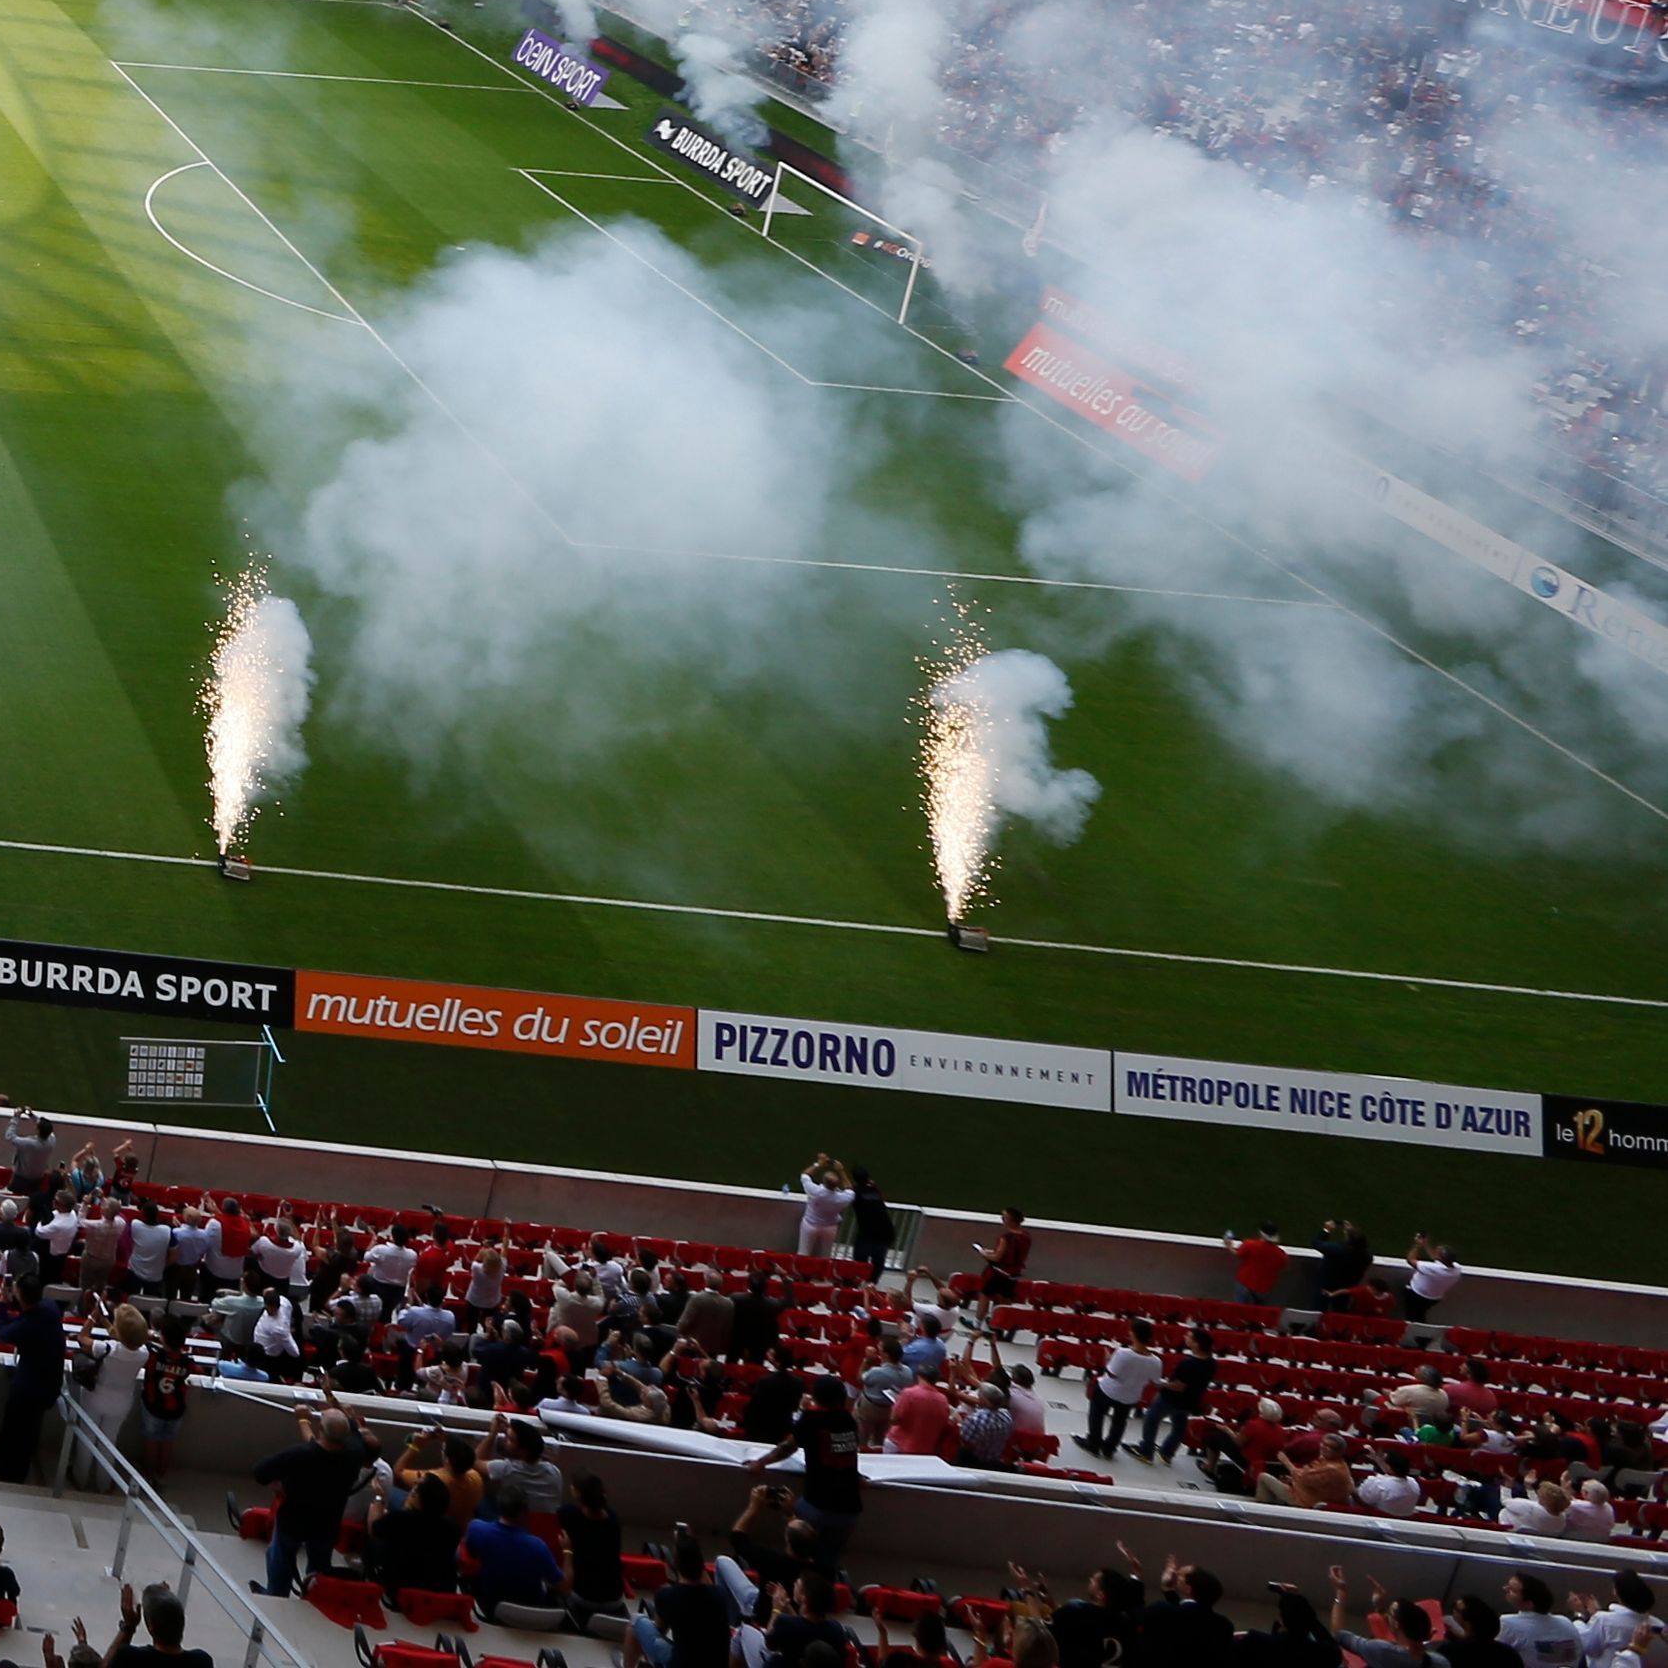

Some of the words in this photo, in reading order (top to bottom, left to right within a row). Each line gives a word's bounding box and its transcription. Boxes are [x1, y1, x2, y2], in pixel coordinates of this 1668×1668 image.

[552, 54, 602, 101] SPORT
[670, 126, 728, 175] BURRDA
[720, 154, 774, 200] SPORT
[1020, 345, 1123, 416] mutuelles
[154, 973, 278, 1013] SPORT
[306, 989, 502, 1039] mutuelles
[509, 1004, 570, 1045] du
[578, 1015, 685, 1056] soleil
[714, 1021, 896, 1078] PIZZORNO
[908, 1054, 1096, 1086] ENVIRONNEMENT
[1126, 1067, 1282, 1114] MÉTROPOLE
[1289, 1088, 1353, 1120] NICE
[1360, 1090, 1427, 1128] CÔTE
[1434, 1103, 1532, 1139] D'AZUR
[1555, 1124, 1575, 1145] le
[1572, 1108, 1606, 1155] 12
[157, 1375, 177, 1395] 6
[1101, 1636, 1124, 1668] 2
